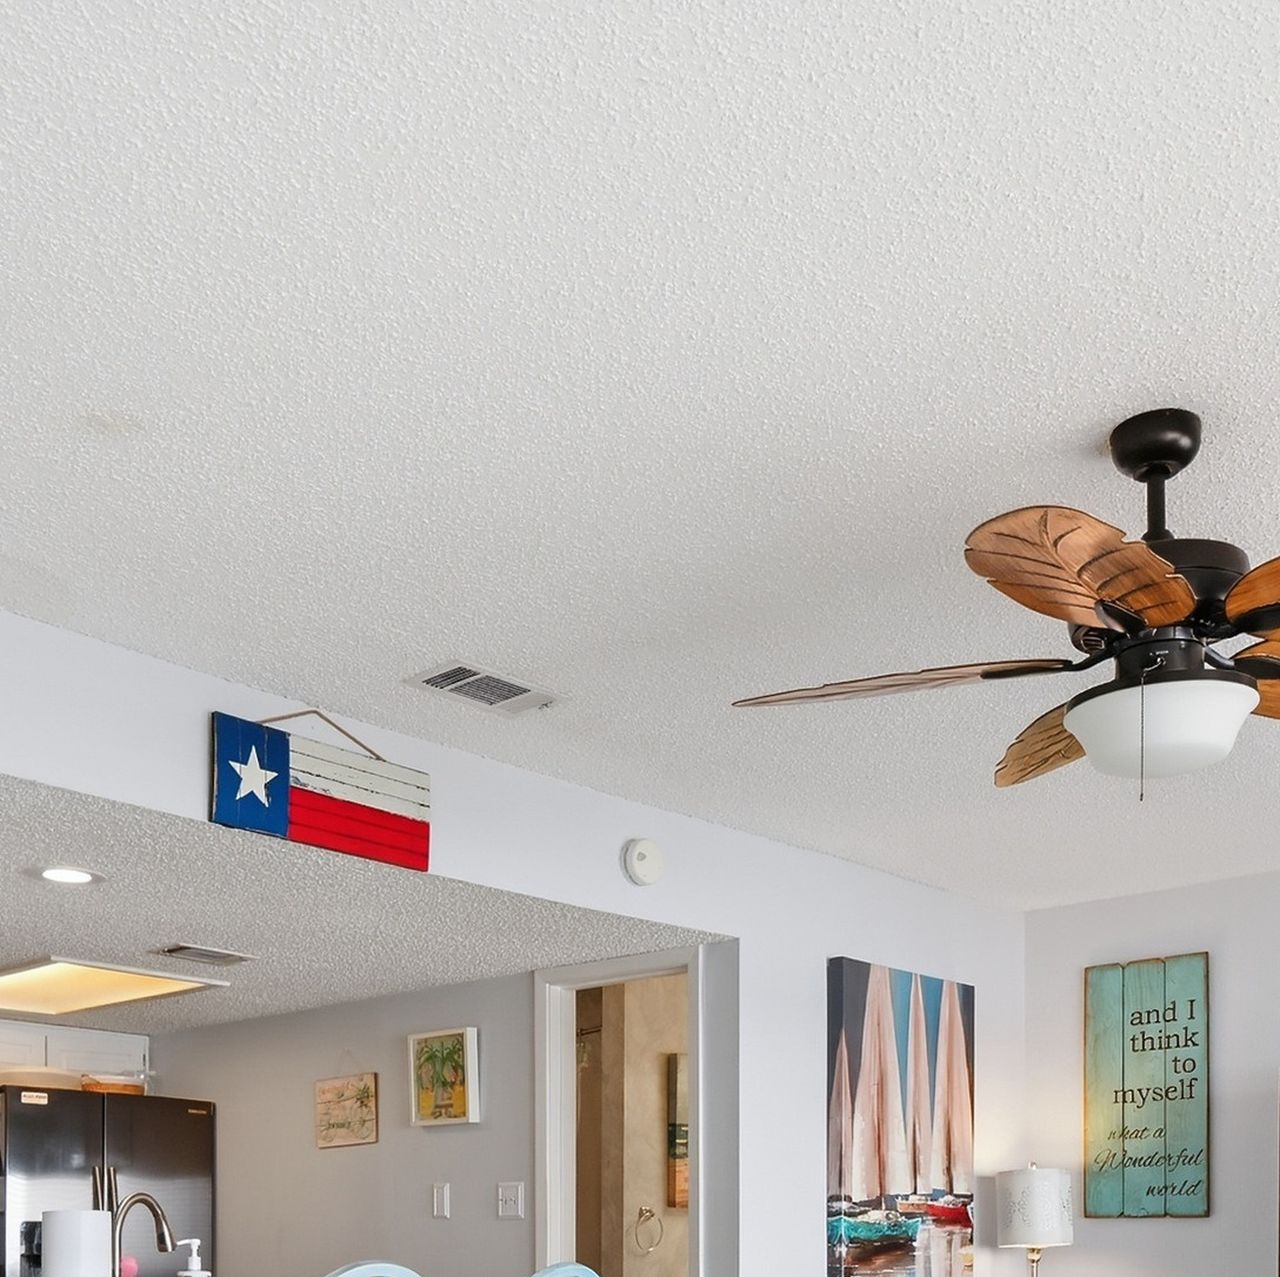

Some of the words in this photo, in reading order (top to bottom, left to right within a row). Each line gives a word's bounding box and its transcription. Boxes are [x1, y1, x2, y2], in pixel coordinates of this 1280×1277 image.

[1129, 1000, 1178, 1026] and
[1187, 999, 1197, 1021] I
[1129, 1026, 1200, 1053] think
[1171, 1055, 1197, 1075] to
[1113, 1077, 1199, 1109] myself
[1107, 1125, 1150, 1140] what
[1152, 1127, 1167, 1140] a
[1145, 1179, 1203, 1197] world
